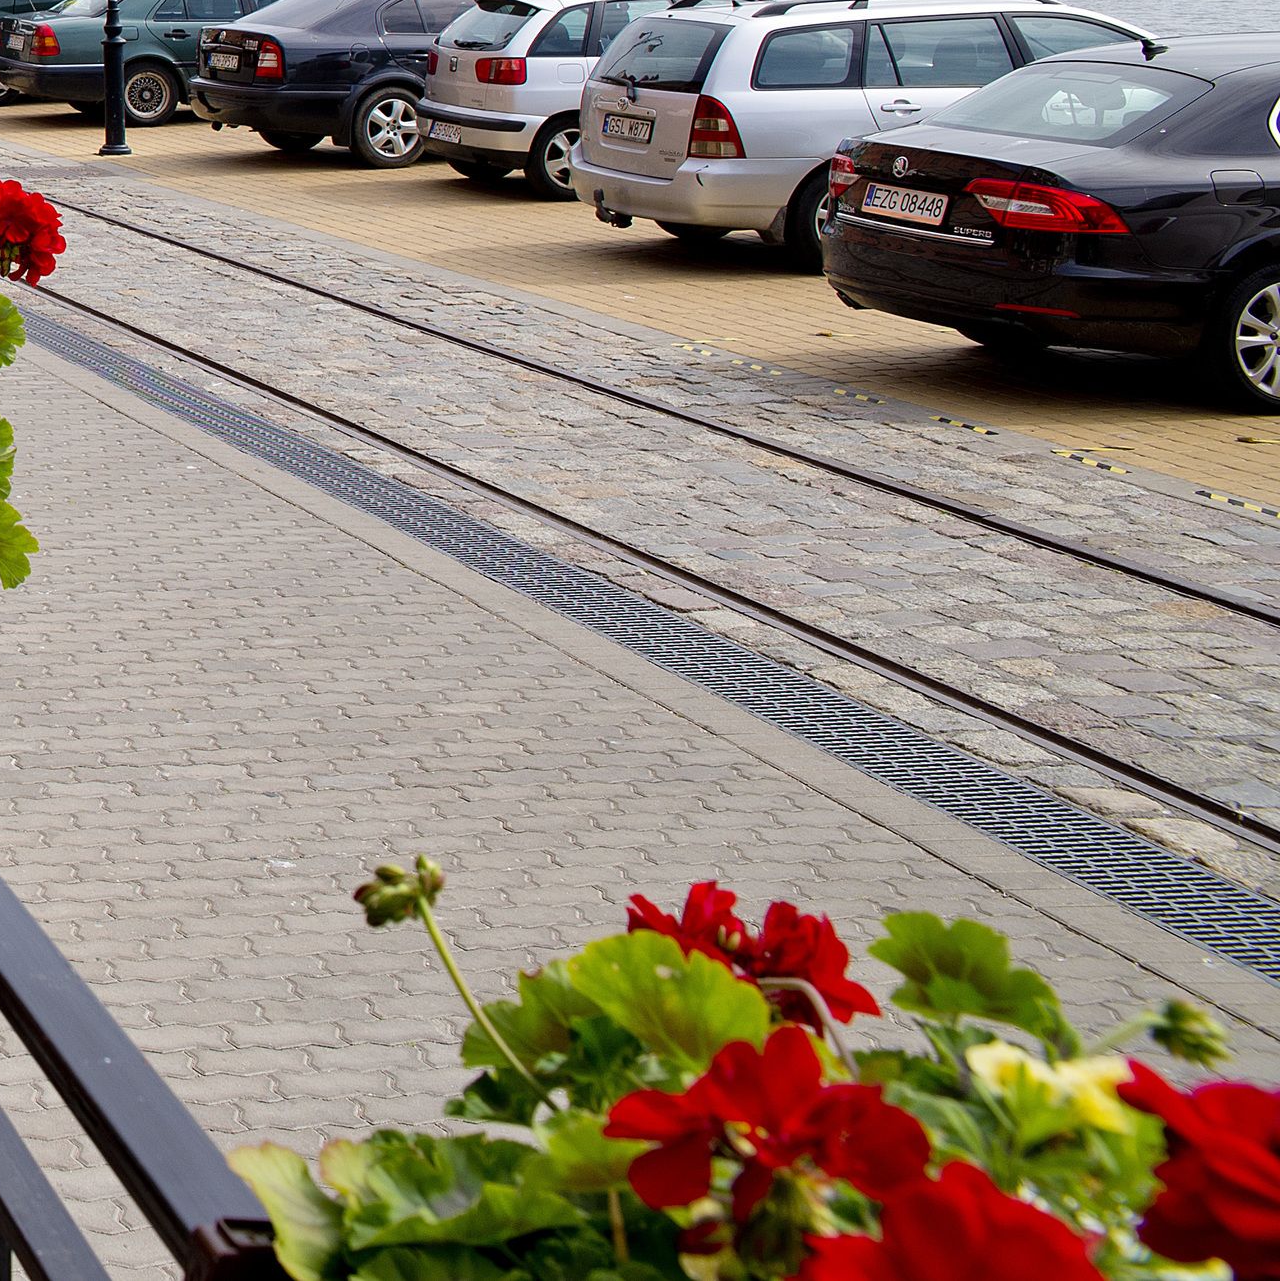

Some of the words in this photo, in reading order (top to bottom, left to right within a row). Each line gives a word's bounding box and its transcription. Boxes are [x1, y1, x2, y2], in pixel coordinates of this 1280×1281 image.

[608, 118, 625, 134] GSL
[628, 121, 649, 138] W877
[871, 187, 899, 210] EZG
[900, 192, 944, 218] 08448
[953, 226, 992, 238] SUPERB
